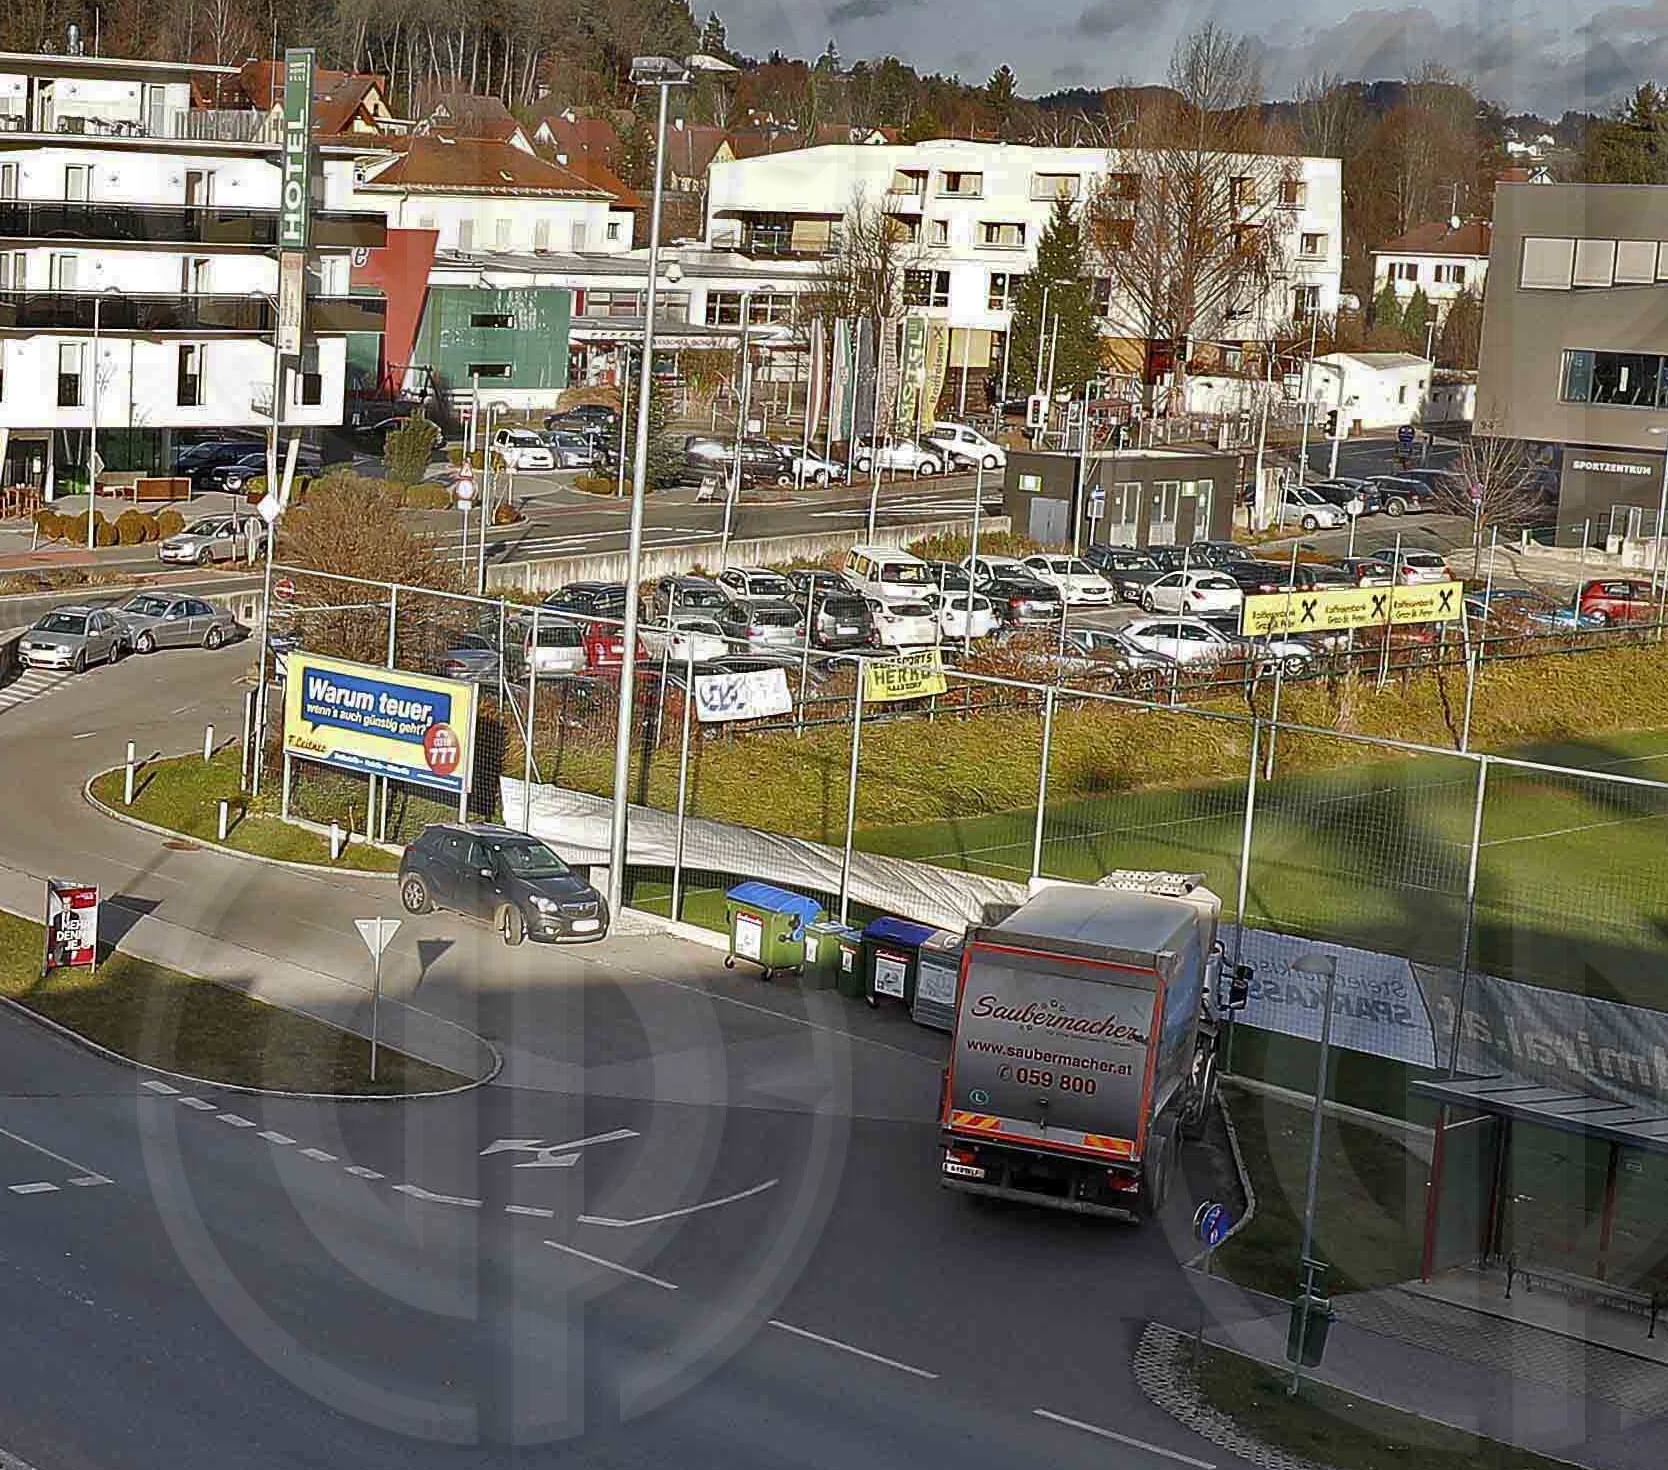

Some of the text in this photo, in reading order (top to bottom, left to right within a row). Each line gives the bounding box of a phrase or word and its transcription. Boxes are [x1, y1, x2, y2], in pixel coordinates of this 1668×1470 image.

[283, 109, 305, 240] HOTEL
[1573, 460, 1651, 475] SPORTZENTRUM
[308, 676, 433, 727] Warum teuer,
[340, 709, 427, 736] auch günstig geht?
[429, 747, 457, 765] 777
[971, 994, 1137, 1040] Saubermacher
[967, 1040, 1132, 1076] www.saubermacher.at
[1016, 1068, 1097, 1095] 059 800
